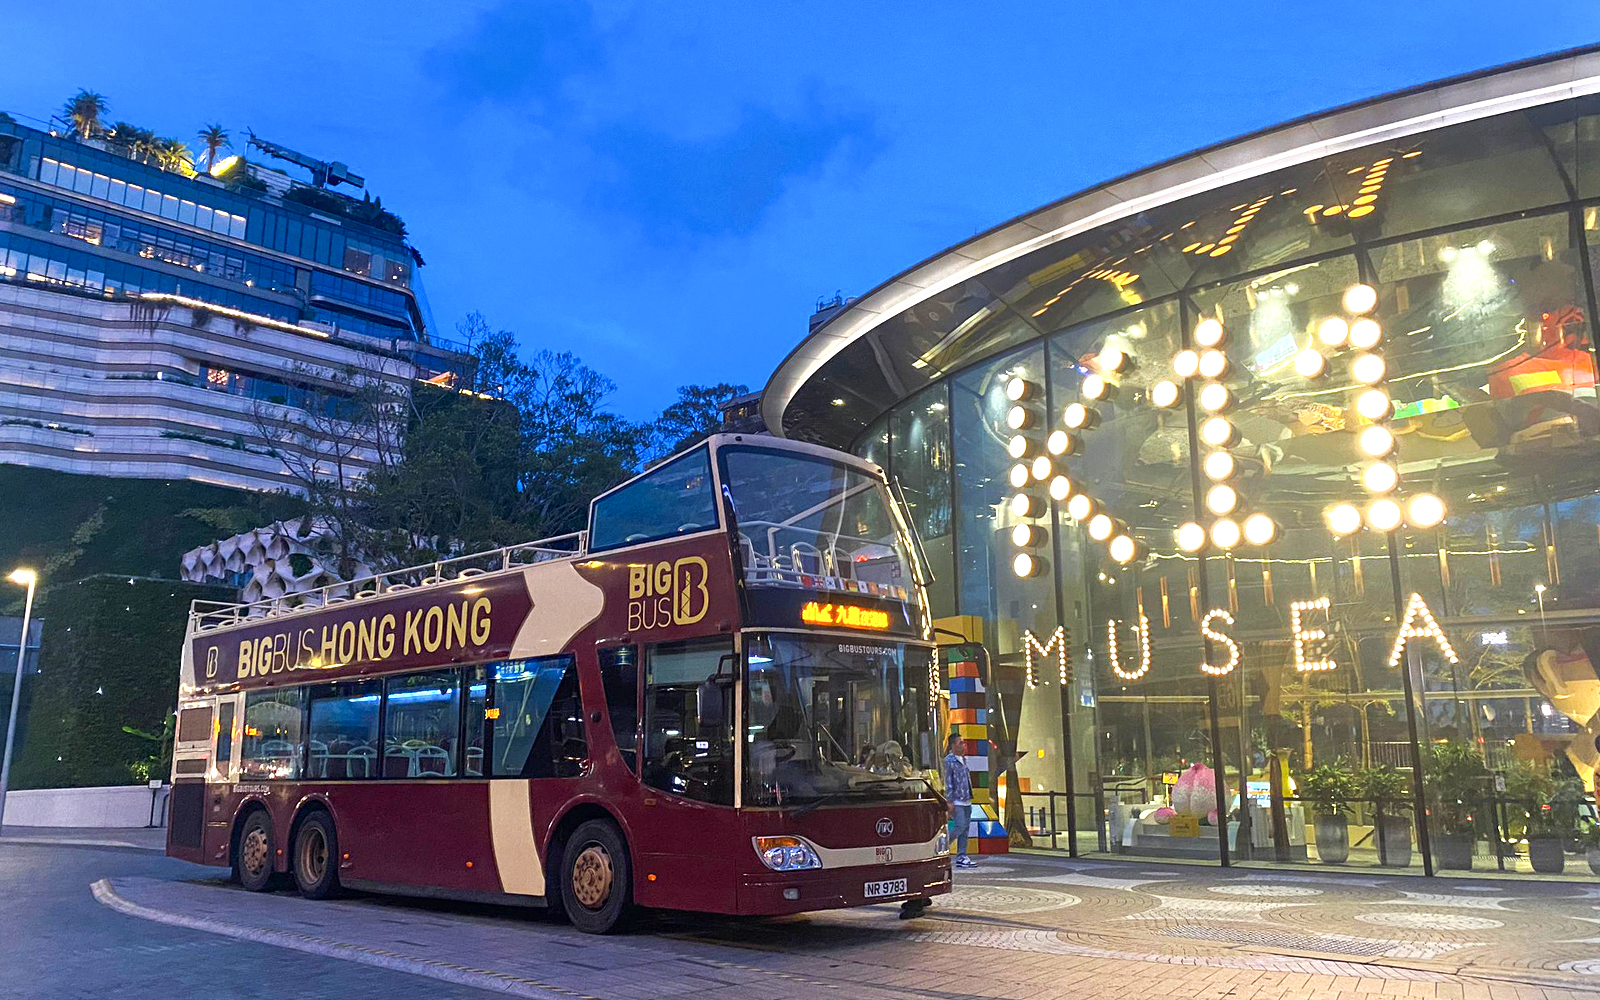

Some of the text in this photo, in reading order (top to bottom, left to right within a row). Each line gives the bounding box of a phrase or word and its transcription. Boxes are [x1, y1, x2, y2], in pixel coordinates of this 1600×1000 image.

[1006, 283, 1448, 578] K11
[629, 560, 672, 599] BIG
[320, 612, 397, 666] HONG
[402, 596, 493, 657] KONG
[627, 596, 672, 632] BUS
[838, 643, 897, 657] BIGBUSTOURS.COM
[1024, 592, 1460, 690] MUSEA
[867, 881, 905, 895] NR 9783
